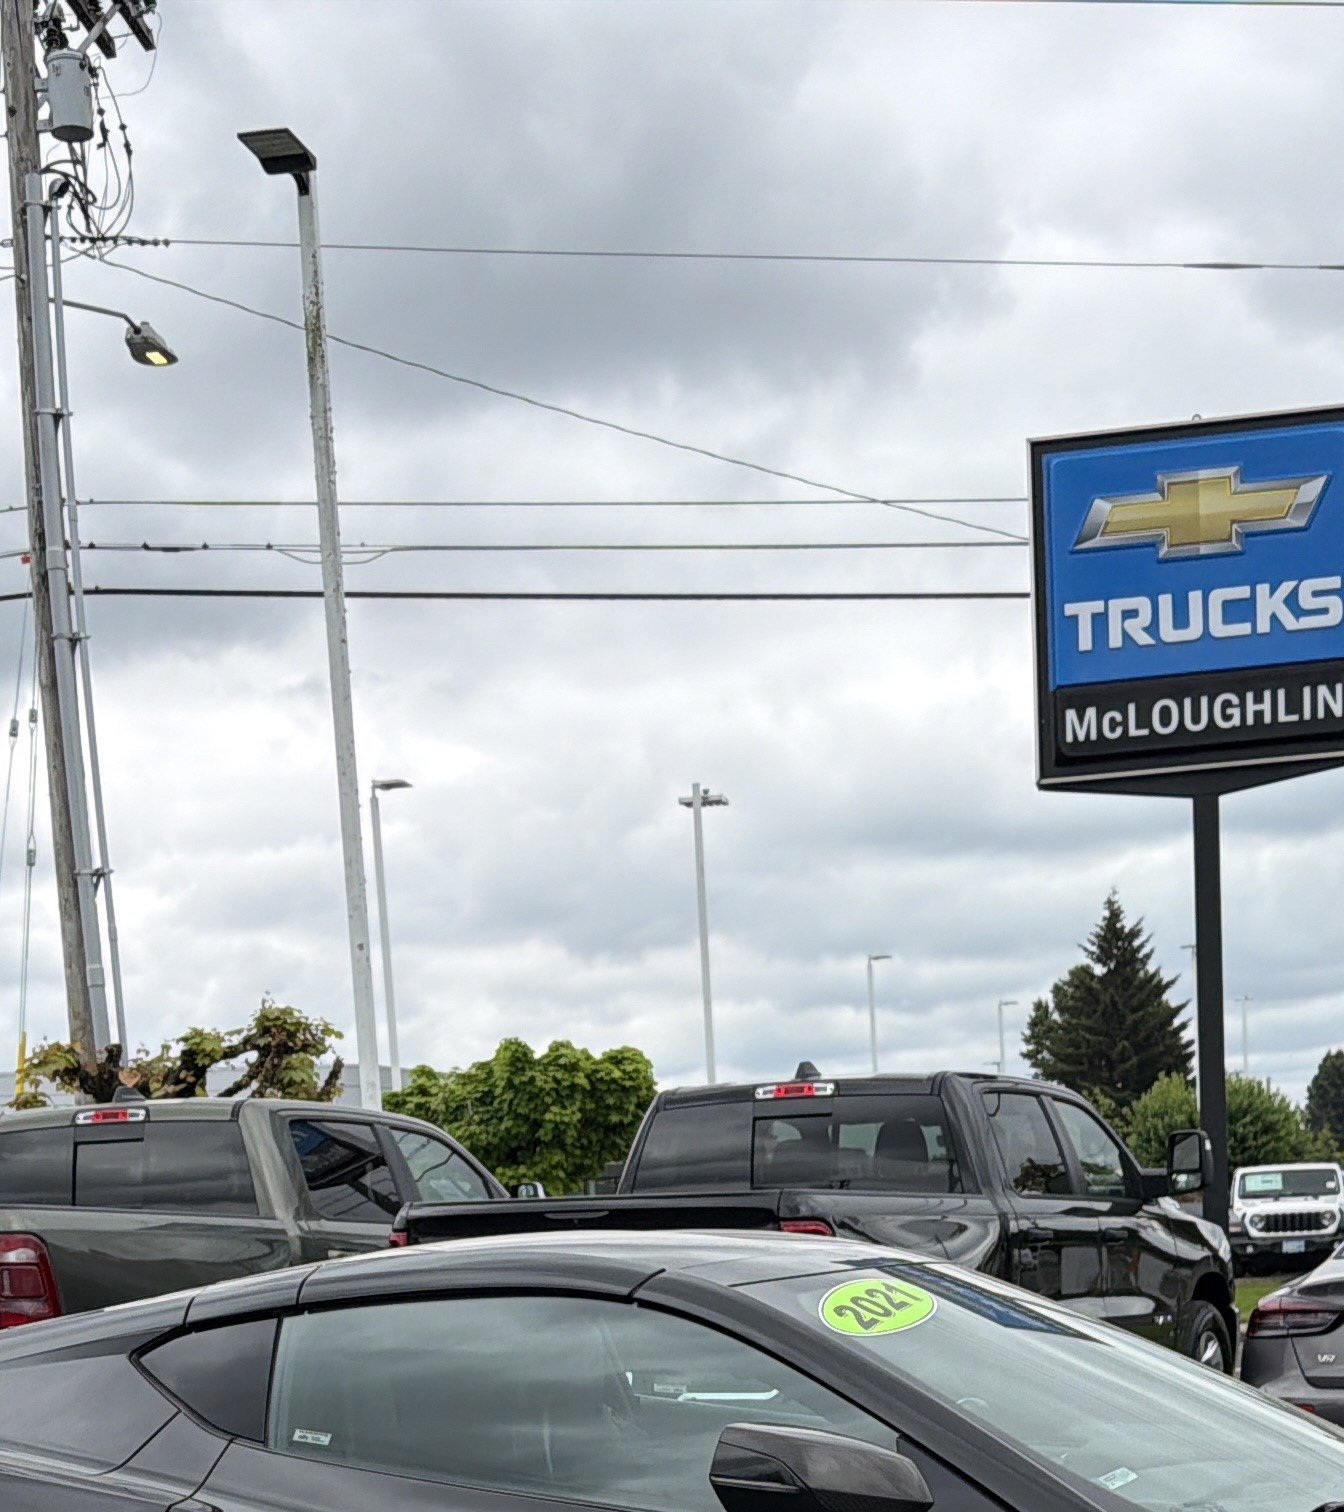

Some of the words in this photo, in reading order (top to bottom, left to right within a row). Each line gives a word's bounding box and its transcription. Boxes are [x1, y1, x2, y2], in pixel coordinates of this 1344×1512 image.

[1064, 575, 1343, 652] TRUCKS
[1065, 682, 1344, 744] McLOUGHLIN
[833, 1282, 924, 1331] 2021
